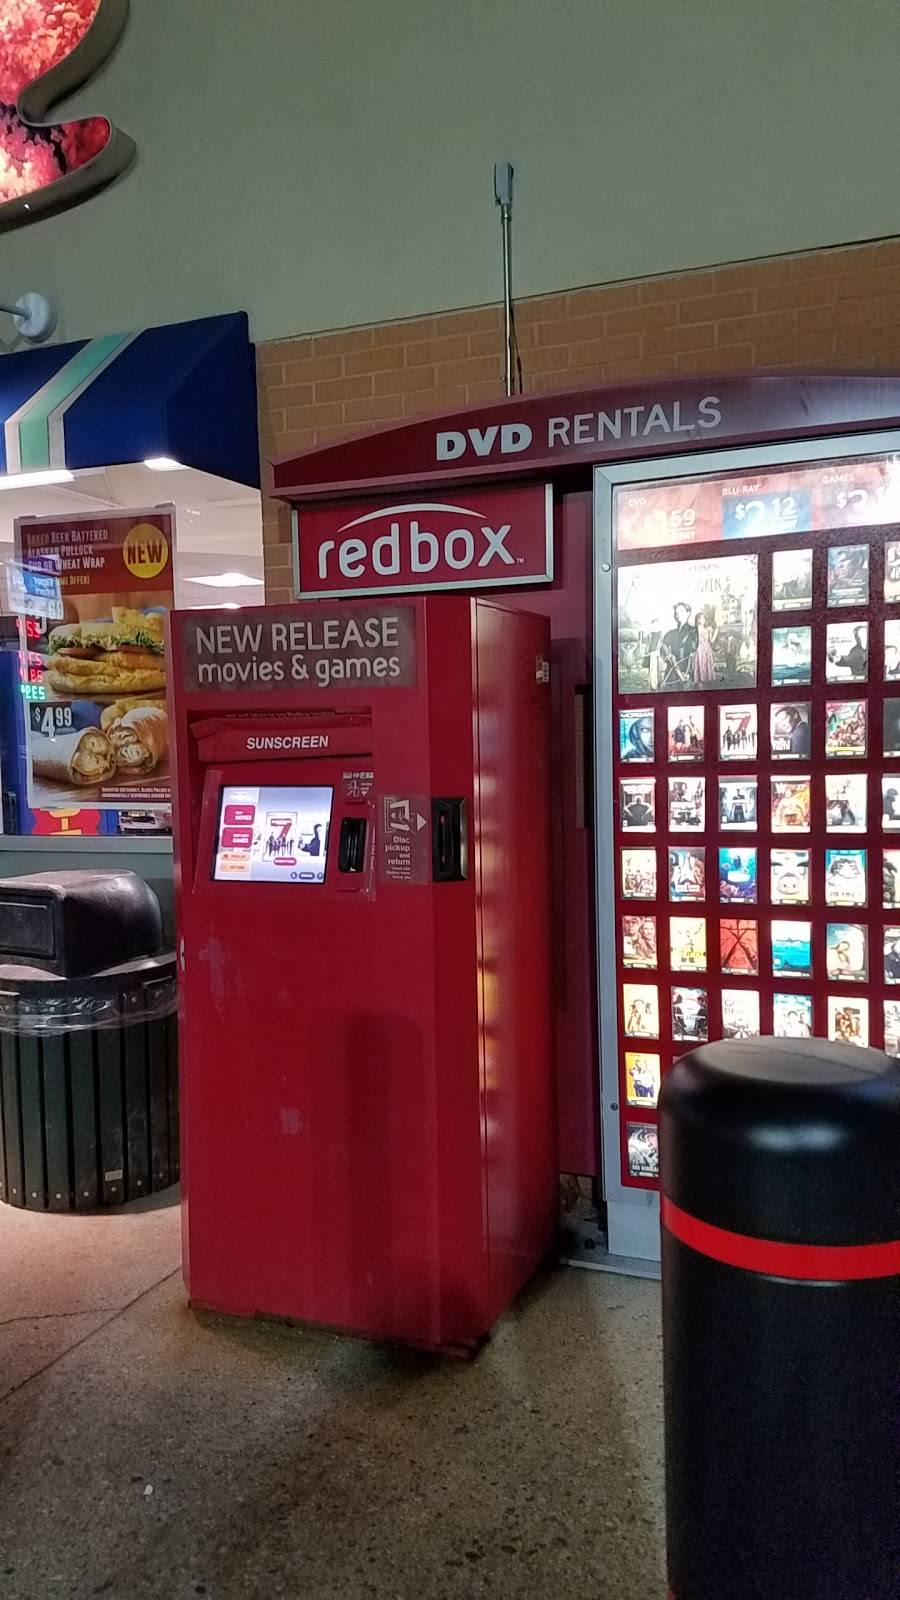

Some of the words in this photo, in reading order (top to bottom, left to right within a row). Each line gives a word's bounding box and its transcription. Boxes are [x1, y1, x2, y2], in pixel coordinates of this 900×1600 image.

[436, 423, 533, 461] DVD
[548, 396, 722, 448] RENTALS
[51, 531, 71, 544] BEER
[71, 529, 108, 541] BATTERED
[61, 545, 94, 557] POLLOCK
[127, 539, 162, 564] NEW
[318, 521, 515, 580] redbox
[54, 558, 81, 571] WHEAT
[82, 557, 106, 569] WRAP
[196, 623, 263, 655] NEW
[271, 617, 400, 651] RELEASE
[198, 656, 284, 683] movies
[291, 654, 310, 680] &
[315, 656, 401, 688] games
[246, 735, 329, 750] SUNSCREEN
[393, 835, 410, 844] Disc
[384, 844, 411, 853] pickup
[387, 858, 411, 866] return
